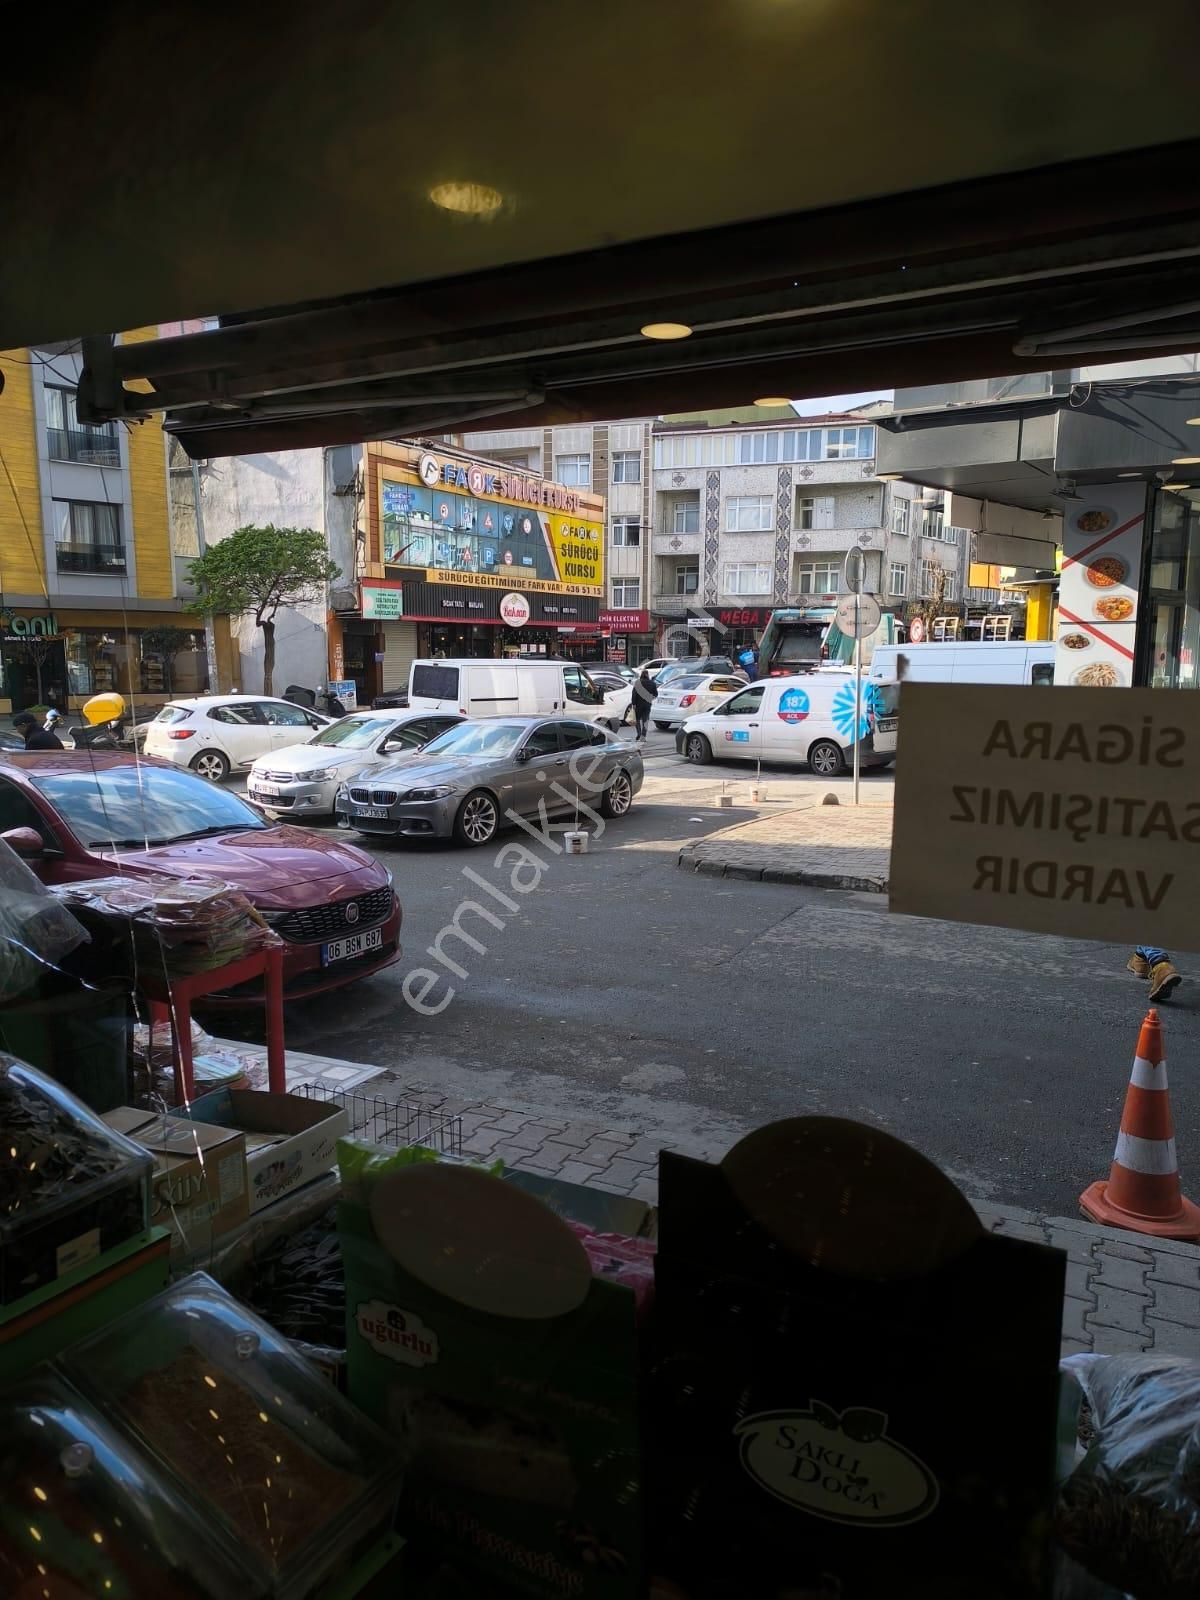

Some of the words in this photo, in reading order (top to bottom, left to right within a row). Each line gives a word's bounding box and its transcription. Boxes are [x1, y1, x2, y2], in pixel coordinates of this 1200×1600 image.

[561, 542, 599, 562] SÜRÜCÜ
[565, 562, 596, 579] KURSU
[528, 582, 546, 592] FARK
[721, 609, 759, 625] MEGA
[786, 696, 805, 706] 187
[328, 944, 341, 960] 06
[361, 1318, 433, 1356] uğurlu
